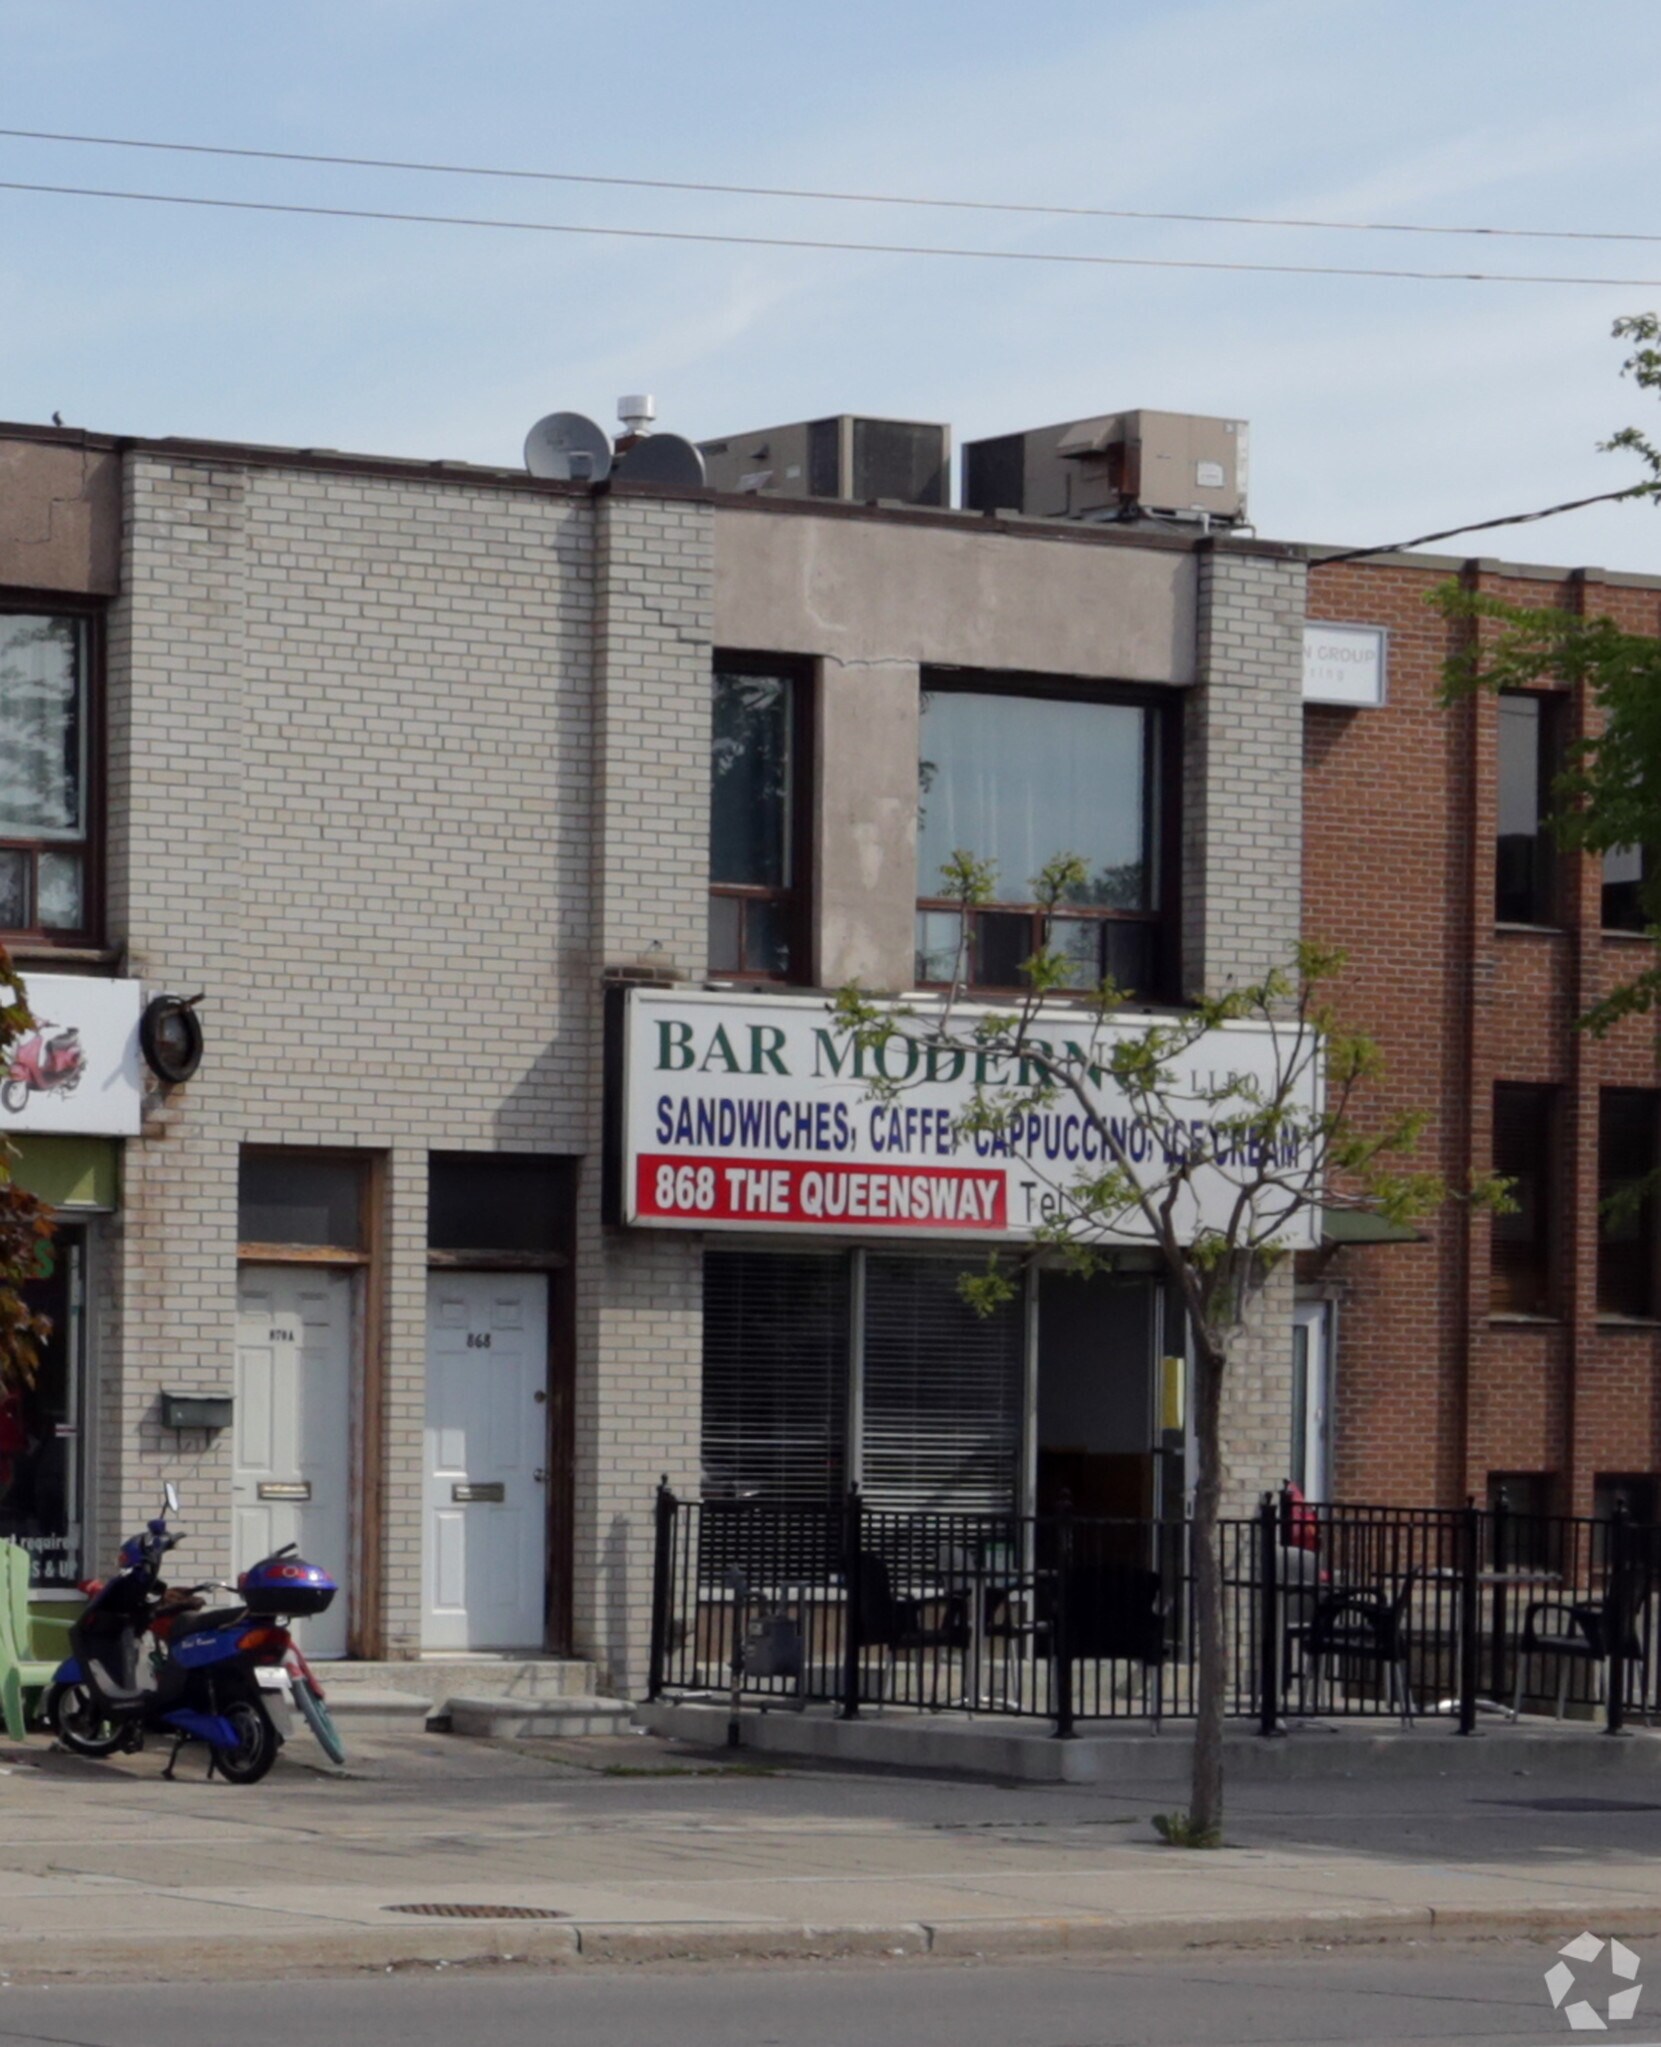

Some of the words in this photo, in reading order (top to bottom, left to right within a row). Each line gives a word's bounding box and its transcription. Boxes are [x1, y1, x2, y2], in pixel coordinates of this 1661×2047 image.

[1317, 645, 1377, 663] GROUP
[653, 1019, 793, 1077] BAR
[656, 1094, 857, 1153] SANDWICHES,
[869, 1105, 959, 1157] CAFFE,
[654, 1164, 716, 1211] 868
[725, 1167, 792, 1214] THE
[799, 1170, 999, 1221] QUEENSWAY
[466, 1333, 491, 1349] 868
